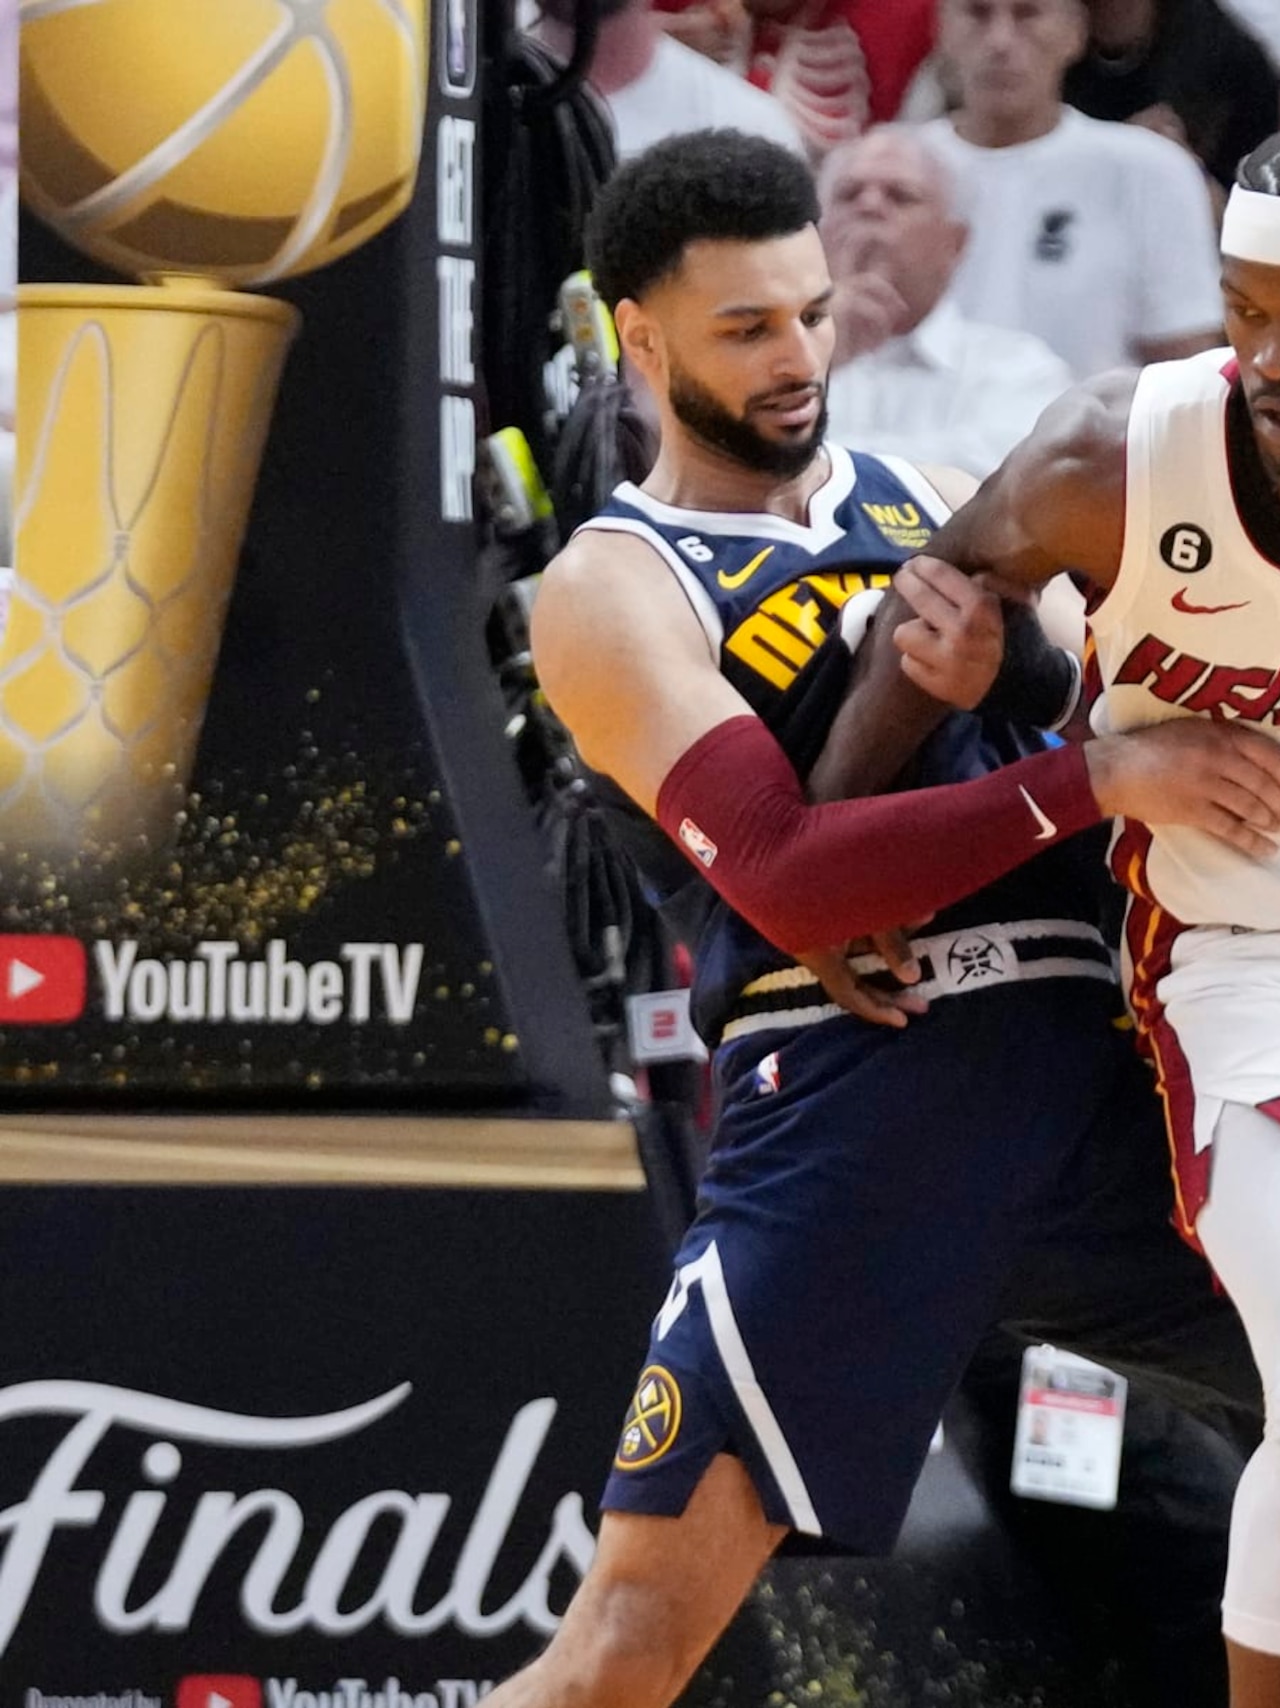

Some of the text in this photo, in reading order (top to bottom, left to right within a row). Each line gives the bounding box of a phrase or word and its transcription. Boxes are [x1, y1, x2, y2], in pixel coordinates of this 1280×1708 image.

[861, 502, 921, 528] WU
[676, 535, 714, 563] 6
[1171, 529, 1202, 569] 6
[0, 1378, 599, 1658] Finals
